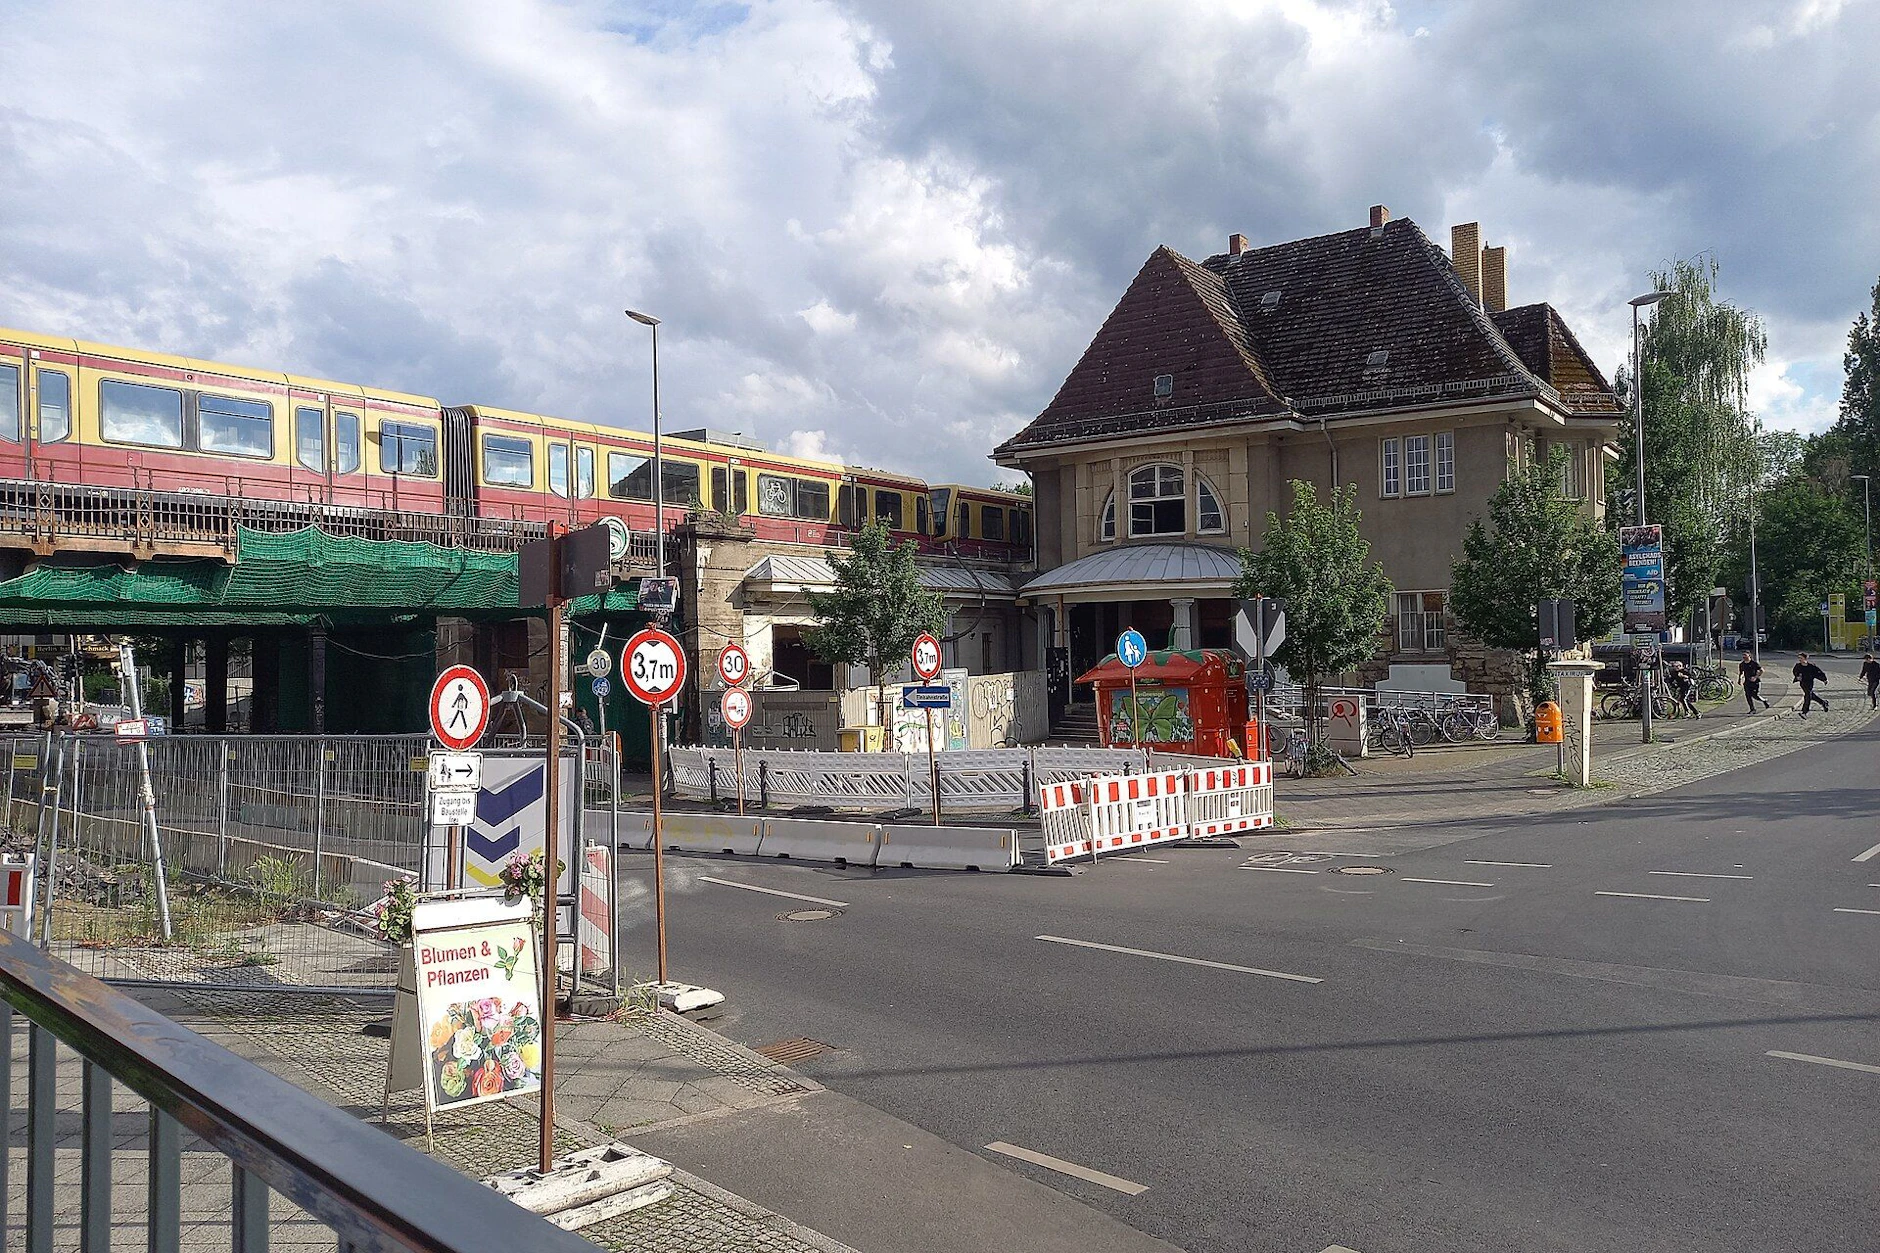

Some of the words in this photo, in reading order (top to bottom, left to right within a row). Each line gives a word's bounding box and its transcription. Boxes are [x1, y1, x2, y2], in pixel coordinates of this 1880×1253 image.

[592, 657, 607, 670] 30
[724, 655, 744, 673] 30
[438, 796, 461, 807] Zugang
[462, 797, 471, 805] bis
[441, 807, 468, 816] Baustelle
[421, 945, 477, 965] Blumen
[481, 940, 492, 957] &
[427, 967, 490, 988] Pflanzen
